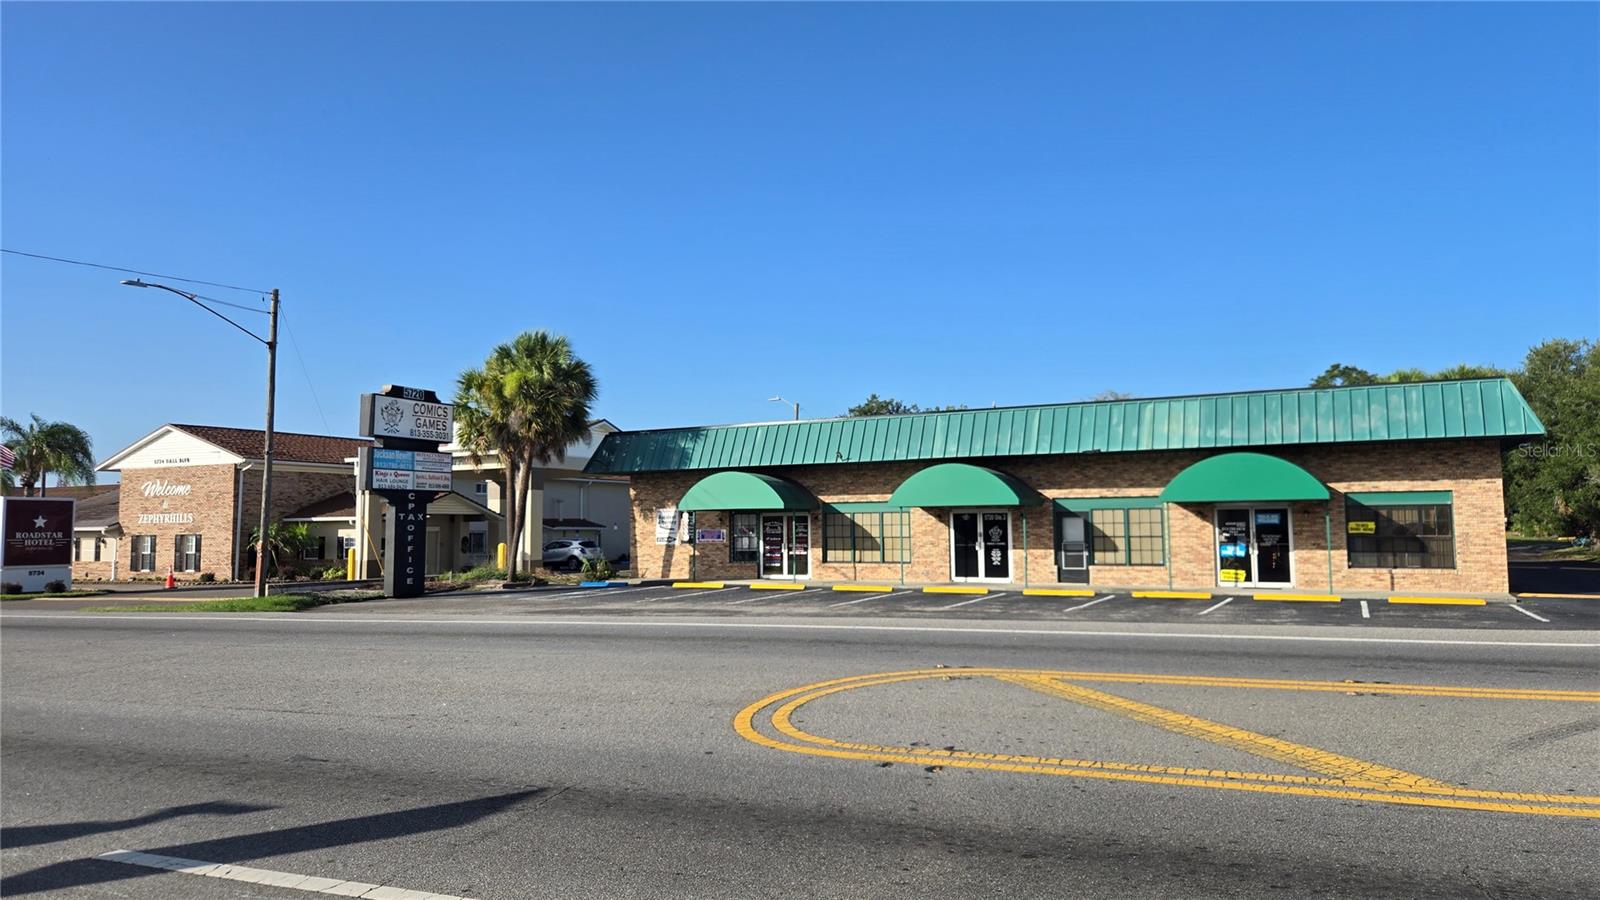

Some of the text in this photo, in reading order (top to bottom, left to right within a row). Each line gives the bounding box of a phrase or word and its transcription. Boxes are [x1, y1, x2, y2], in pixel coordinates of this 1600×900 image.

[404, 388, 424, 399] 5720
[413, 403, 448, 418] COMICS
[415, 418, 447, 431] GAMES
[409, 428, 449, 440] 813-355-3031
[141, 479, 192, 497] Welcome
[137, 512, 193, 524] ZEPHYRHILLS
